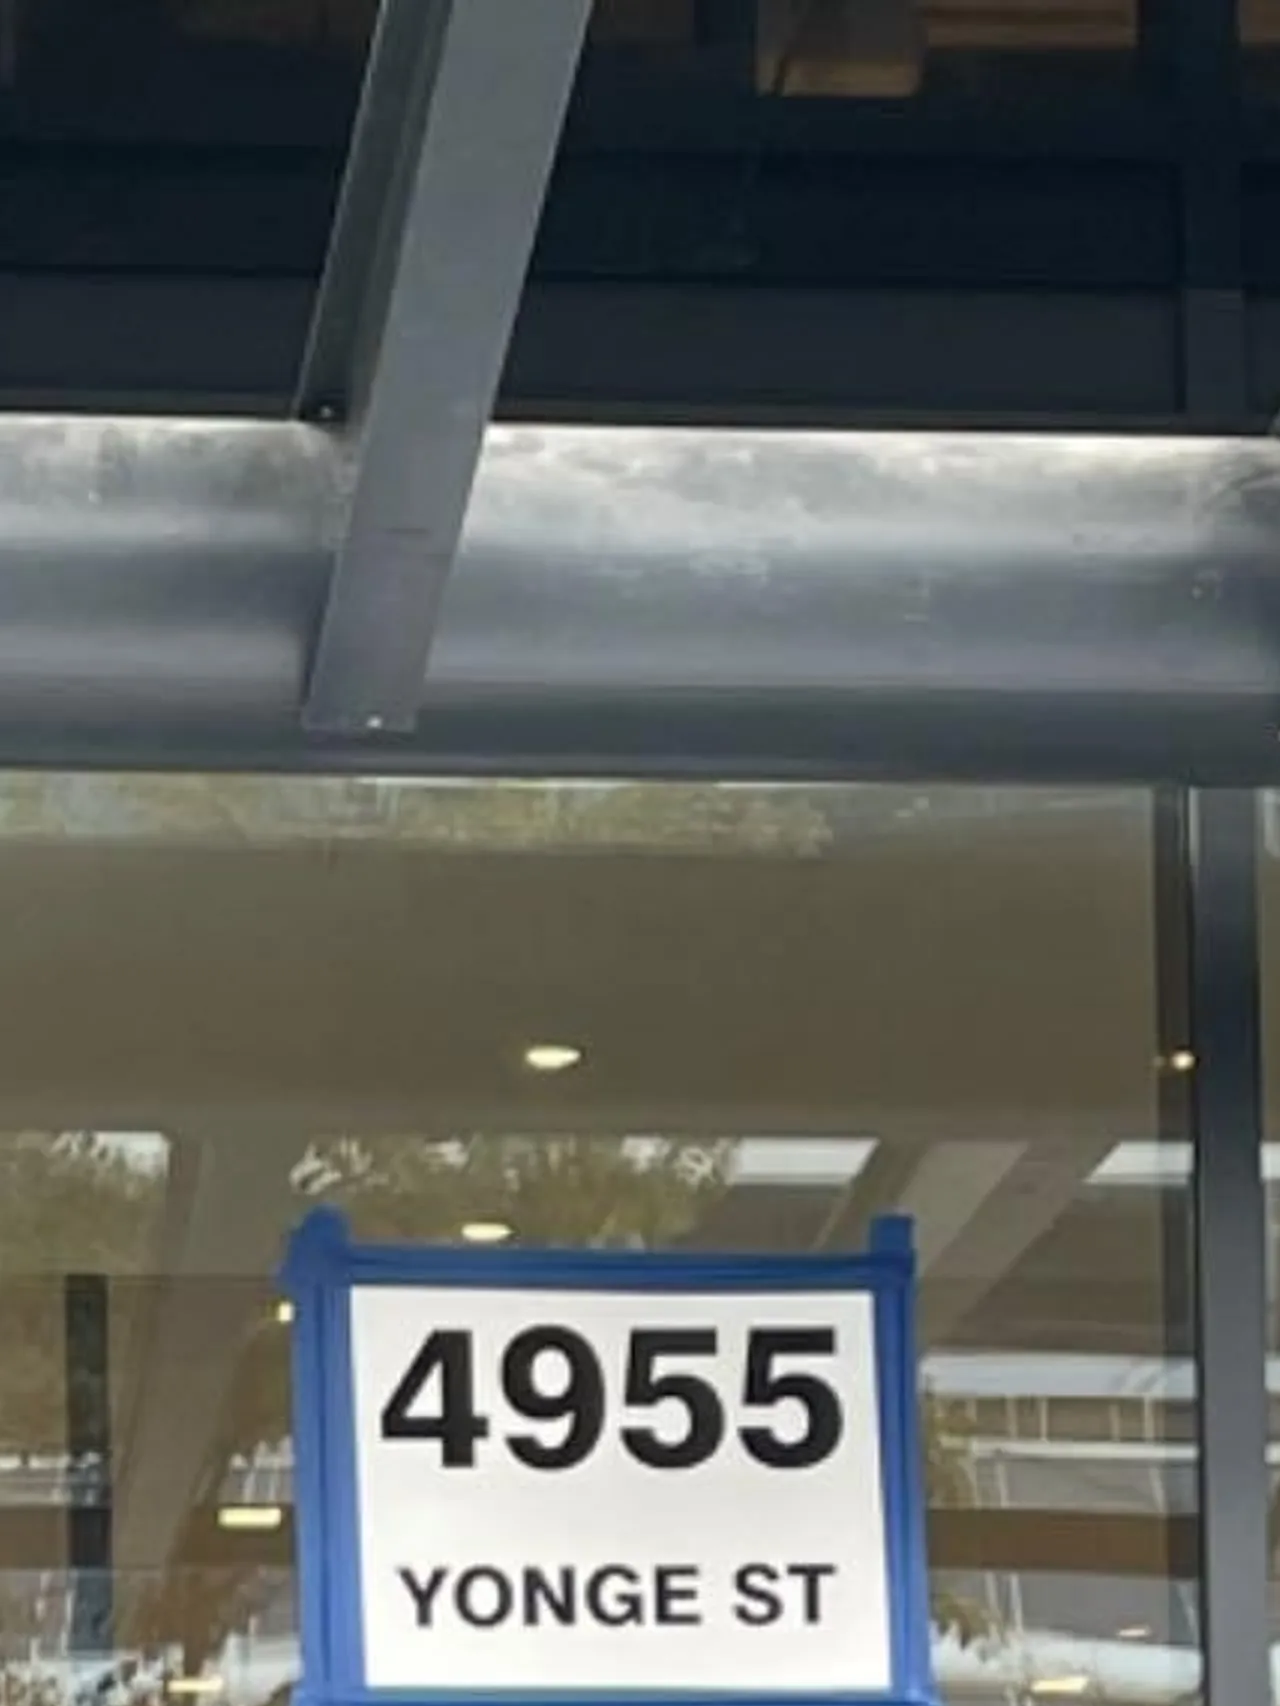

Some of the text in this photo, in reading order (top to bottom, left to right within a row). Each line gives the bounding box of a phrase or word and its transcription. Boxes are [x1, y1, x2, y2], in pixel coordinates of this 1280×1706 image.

[380, 1325, 844, 1470] 4955
[398, 1563, 837, 1628] YONGE ST
